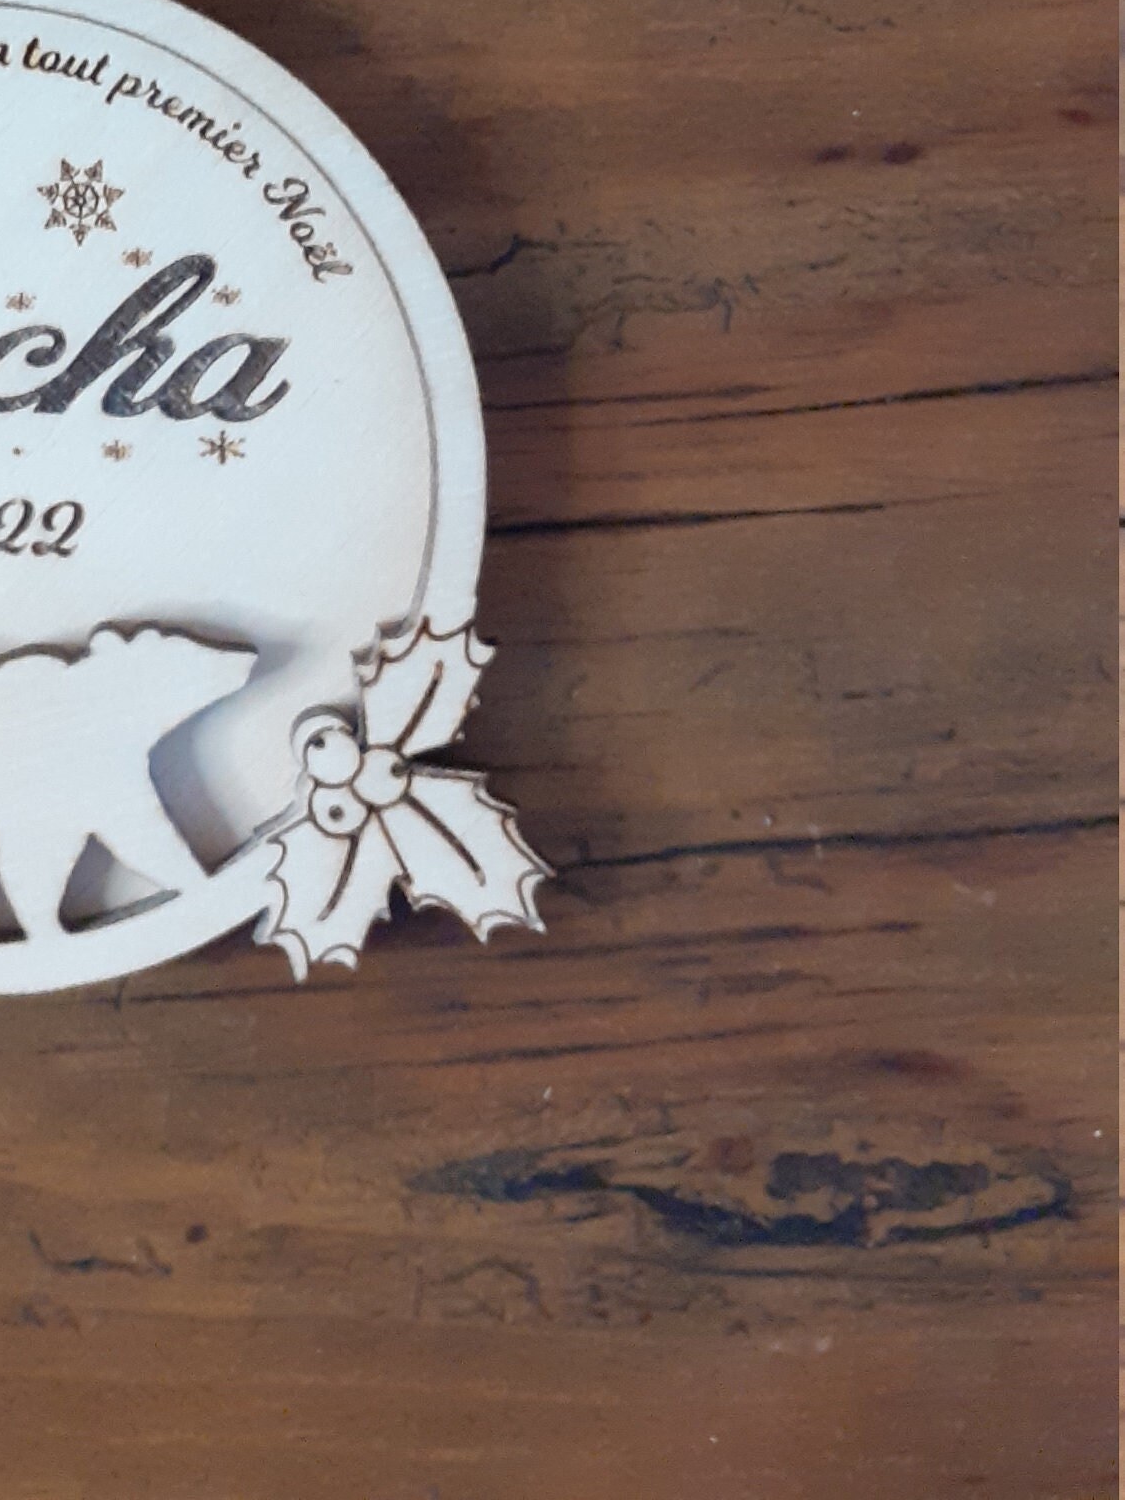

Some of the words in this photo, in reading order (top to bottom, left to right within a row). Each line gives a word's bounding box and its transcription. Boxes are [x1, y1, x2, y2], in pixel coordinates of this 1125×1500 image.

[22, 37, 112, 87] tout
[105, 71, 262, 181] premier
[262, 176, 354, 284] Noël
